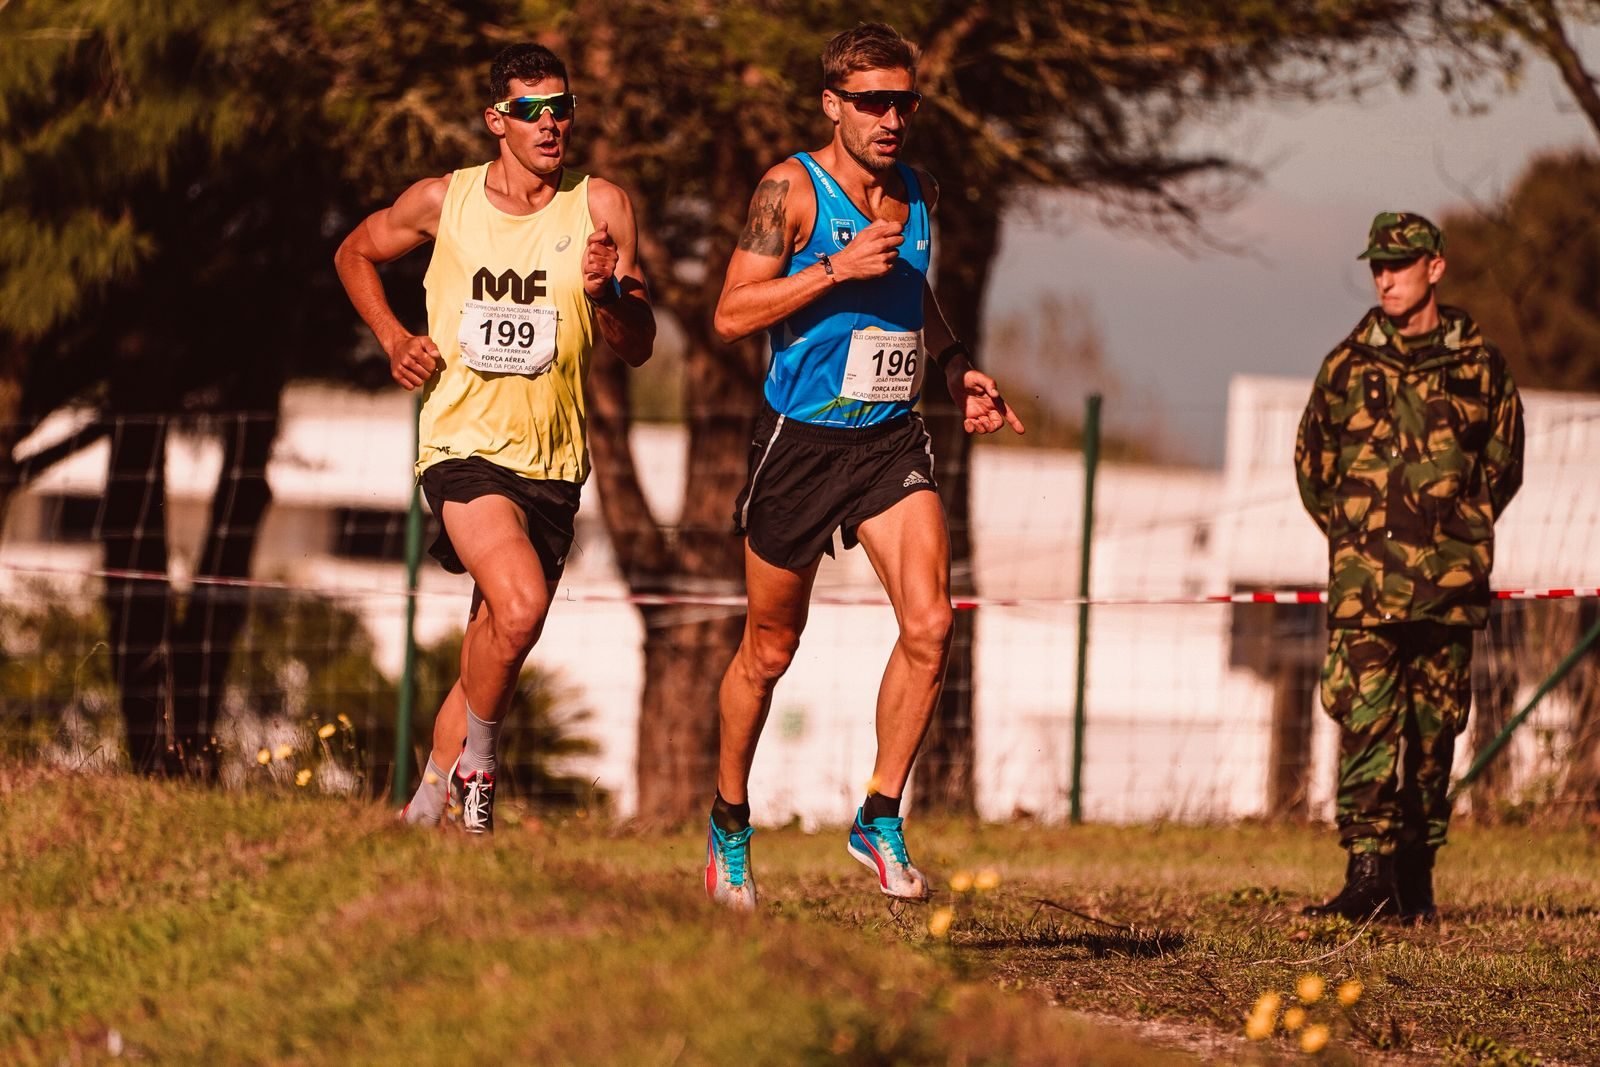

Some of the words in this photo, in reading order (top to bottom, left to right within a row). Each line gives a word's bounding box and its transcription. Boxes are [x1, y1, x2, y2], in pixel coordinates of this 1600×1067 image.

[474, 303, 506, 313] CAMPEONATO
[483, 312, 517, 320] CORTA-MATO
[480, 319, 535, 349] 199
[481, 354, 503, 362] FORÇA
[504, 355, 526, 363] AÉREA
[872, 349, 918, 377] 196
[871, 385, 890, 393] FORÇA
[891, 384, 908, 392] AÉREA
[851, 391, 880, 399] ACADEMIA
